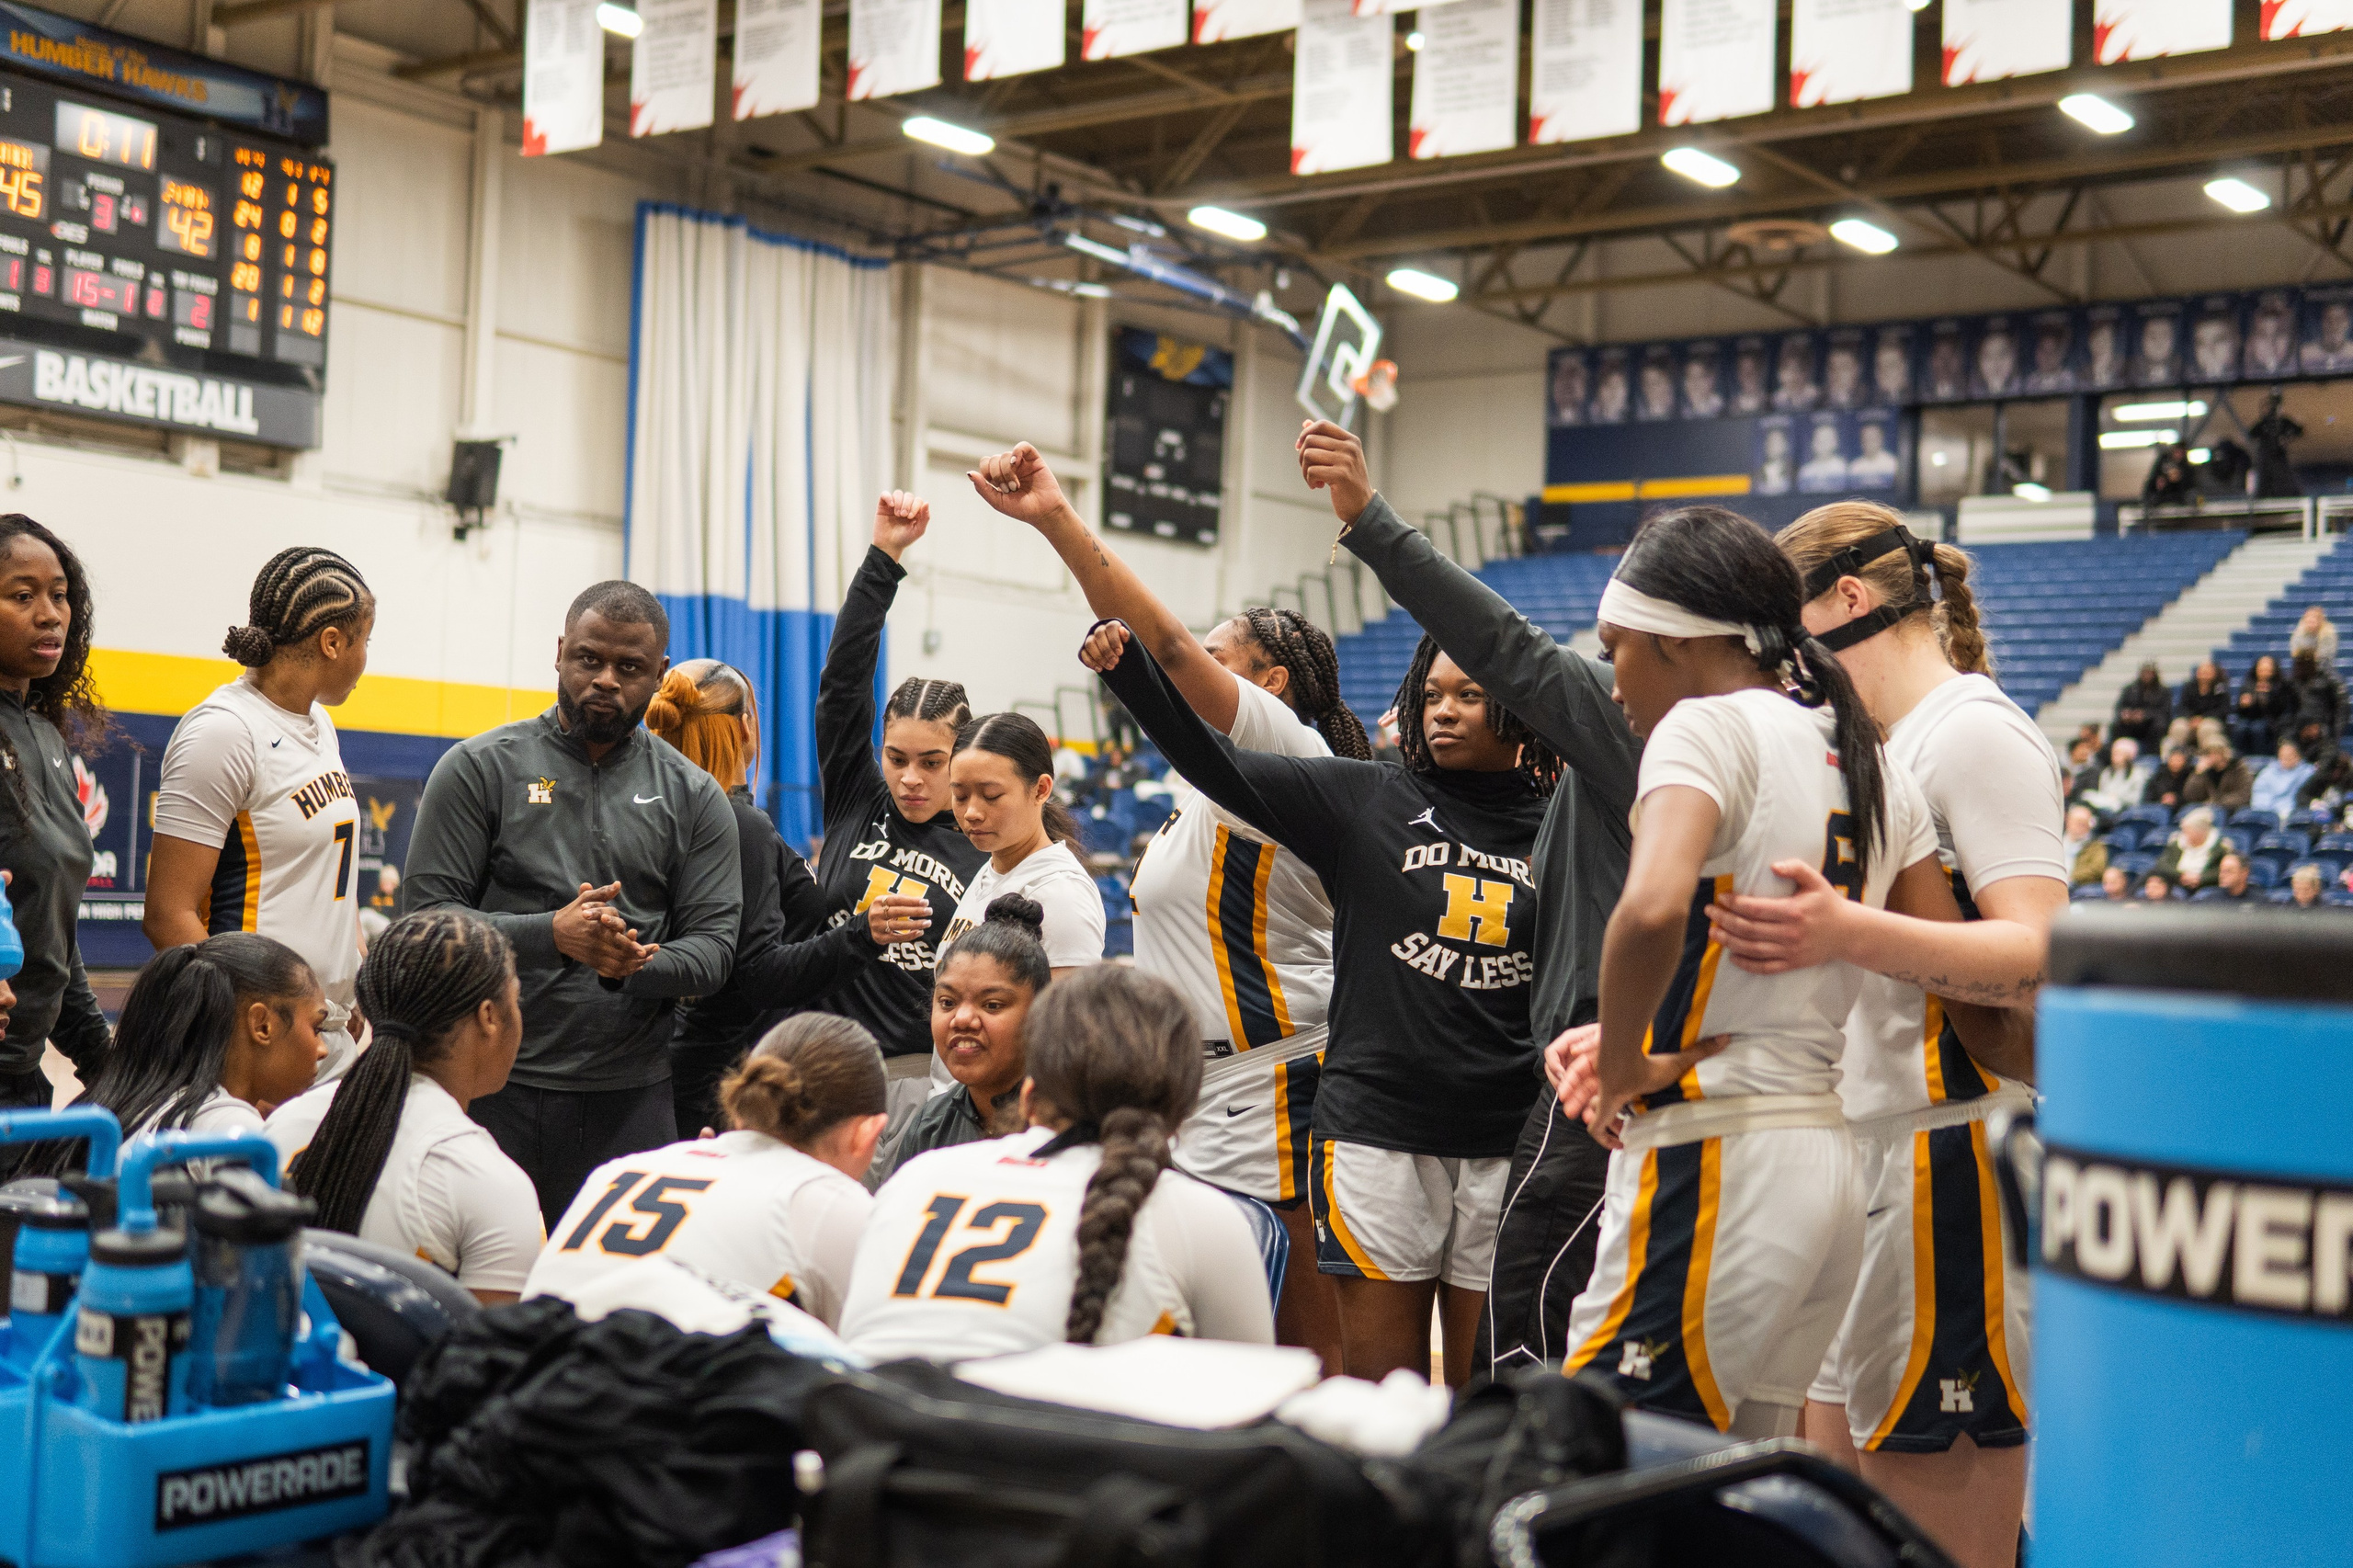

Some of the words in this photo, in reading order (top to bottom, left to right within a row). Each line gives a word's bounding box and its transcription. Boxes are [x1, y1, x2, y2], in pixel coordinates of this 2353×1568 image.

[10, 30, 115, 80] HUMBER
[93, 194, 114, 230] 3
[167, 206, 214, 256] 42
[34, 349, 260, 437] BASKETBALL
[334, 818, 355, 902] 7
[849, 840, 892, 861] DO
[889, 848, 965, 905] MORE
[1402, 841, 1450, 873] DO
[1457, 842, 1537, 890] MOR
[1437, 872, 1515, 948] H
[1391, 932, 1461, 982] SAY
[1460, 950, 1533, 990] LESS
[559, 1169, 719, 1258] 15
[891, 1192, 1051, 1308] 12
[161, 1446, 365, 1522] POWERADE
